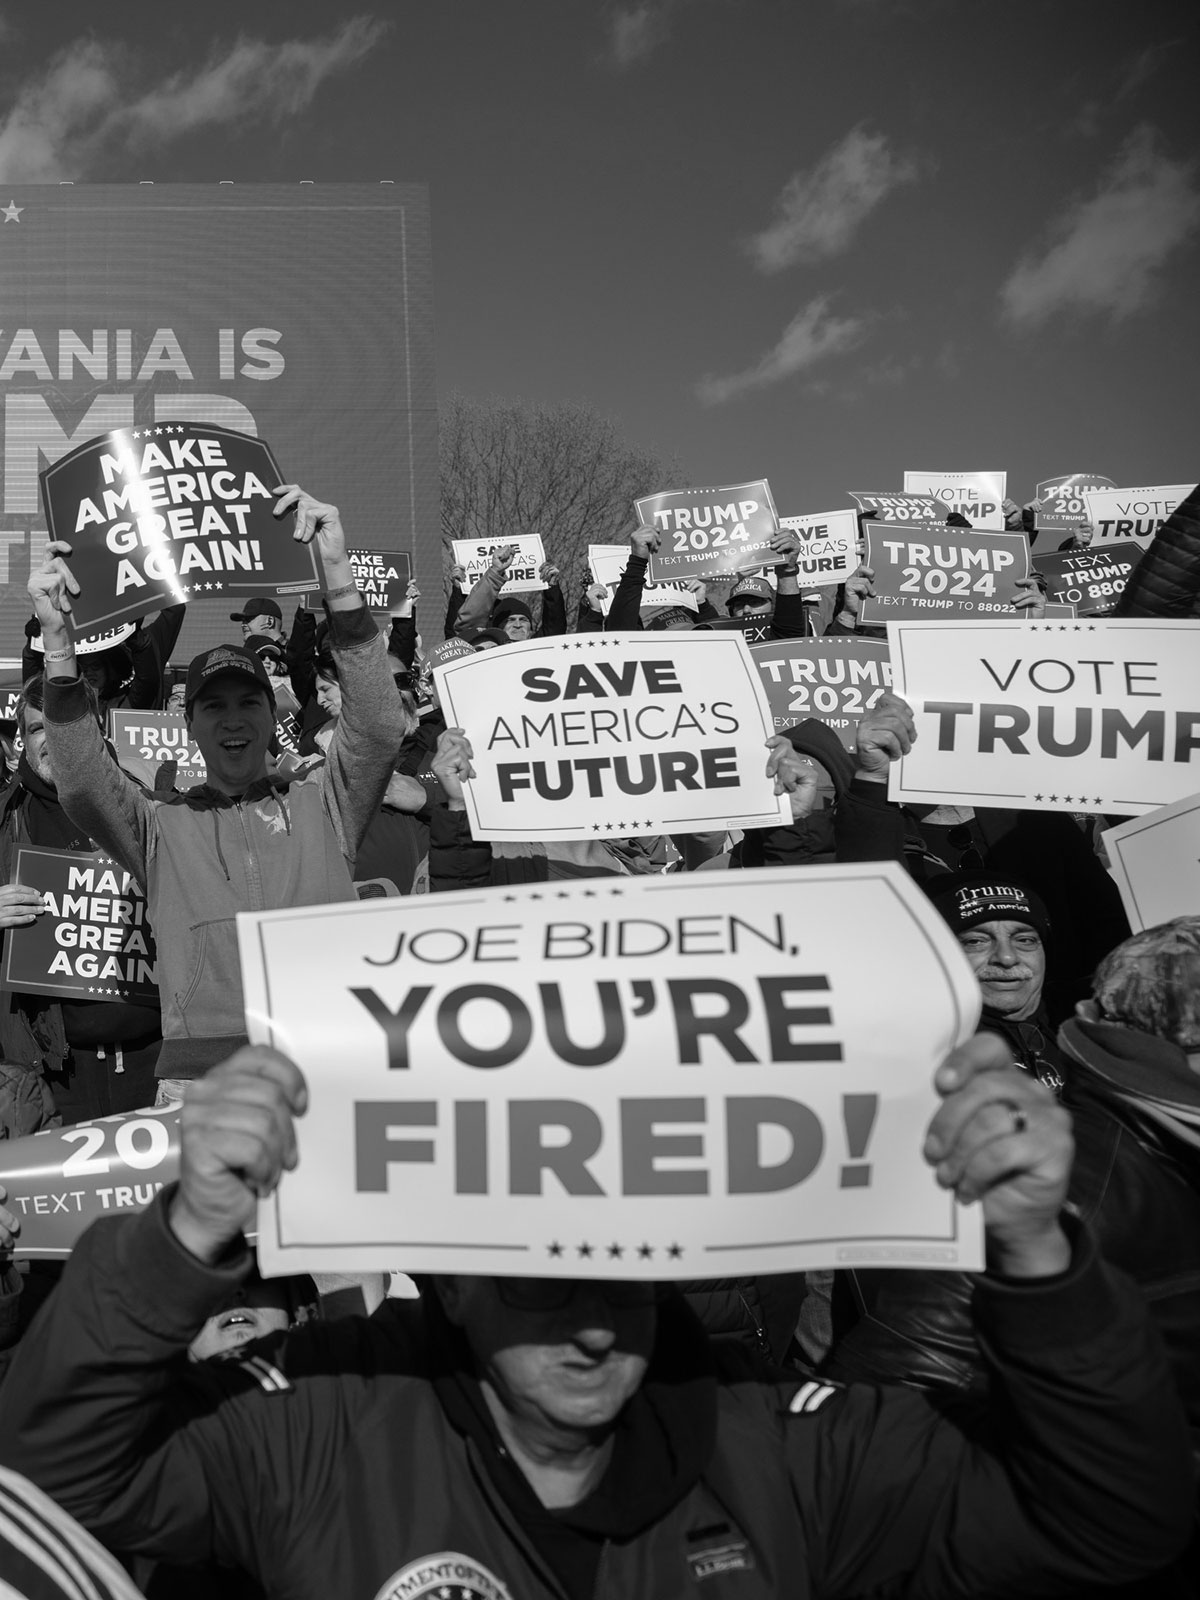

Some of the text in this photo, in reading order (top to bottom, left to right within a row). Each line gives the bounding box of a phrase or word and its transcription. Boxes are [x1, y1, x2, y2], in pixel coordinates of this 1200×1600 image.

[219, 327, 286, 381] IS
[99, 438, 228, 485] MAKE
[74, 470, 273, 533] AMERICA
[863, 496, 936, 507] TRUMP
[928, 487, 979, 500] VOTE
[1043, 484, 1116, 500] TRU
[654, 500, 759, 530] TRUMP
[882, 506, 936, 521] 2024
[952, 503, 997, 518] UMP
[1054, 499, 1087, 514] 20
[1116, 501, 1177, 516] VOTE
[105, 504, 251, 554] GREAT
[672, 523, 750, 552] 2024
[790, 524, 829, 542] AVE
[1098, 518, 1168, 538] TRU
[658, 540, 770, 566] TEXT TRUMP TO 88022
[799, 538, 849, 557] RICA'S
[882, 541, 1015, 572] TRUMP
[115, 540, 265, 596] AGAIN!
[350, 555, 384, 566] AKE
[467, 554, 537, 571] AMECA'S
[762, 555, 847, 577] FTURE
[1062, 553, 1113, 570] TEXT
[350, 565, 399, 579] ERICA
[468, 567, 536, 585] FURE
[1061, 563, 1133, 587] TRUMP
[356, 579, 389, 593] EAT
[606, 578, 688, 592] TUMP
[899, 567, 997, 598] 2024
[1054, 577, 1130, 604] TO 880
[367, 594, 388, 607] IN!
[876, 596, 1017, 614] TEXT TRUMP TO 88022
[744, 625, 771, 642] EX
[434, 640, 454, 655] MAKE
[440, 649, 462, 662] GREAT
[521, 660, 683, 703] SAVE
[980, 658, 1162, 697] VOTE
[488, 702, 740, 750] AMERICA'S
[773, 716, 798, 727] EXT
[124, 726, 199, 746] TRUM
[183, 769, 195, 777] TO
[496, 747, 741, 802] FUTURE
[955, 884, 1025, 903] Trump
[43, 891, 153, 927] AMERI
[960, 903, 1031, 919] Save America
[54, 922, 155, 955] GREA
[363, 913, 800, 968] JOE BIDEN,
[47, 950, 158, 985] AGAIN
[347, 974, 845, 1071] YOU'RE
[61, 1119, 170, 1177] 20
[353, 1093, 880, 1197] FIRED!
[15, 1182, 161, 1216] TEXT TRU
